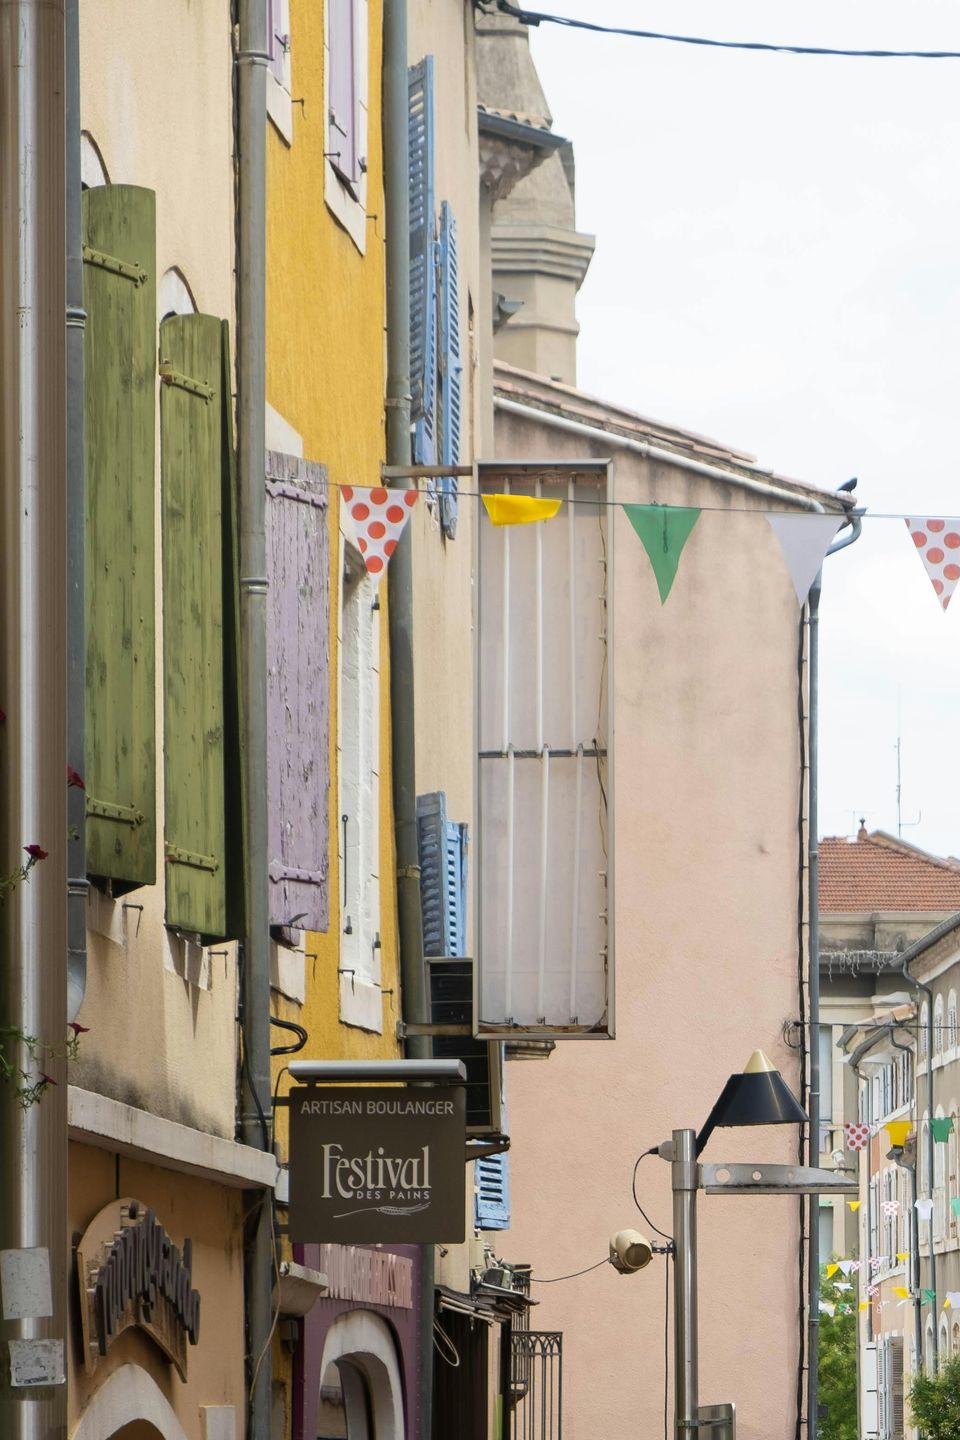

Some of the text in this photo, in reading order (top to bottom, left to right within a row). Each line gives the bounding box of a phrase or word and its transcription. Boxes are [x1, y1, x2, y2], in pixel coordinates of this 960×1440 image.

[300, 1100, 454, 1115] ARTISAN BOULANGER
[320, 1143, 433, 1199] Festival
[356, 1190, 431, 1200] DES PAINS
